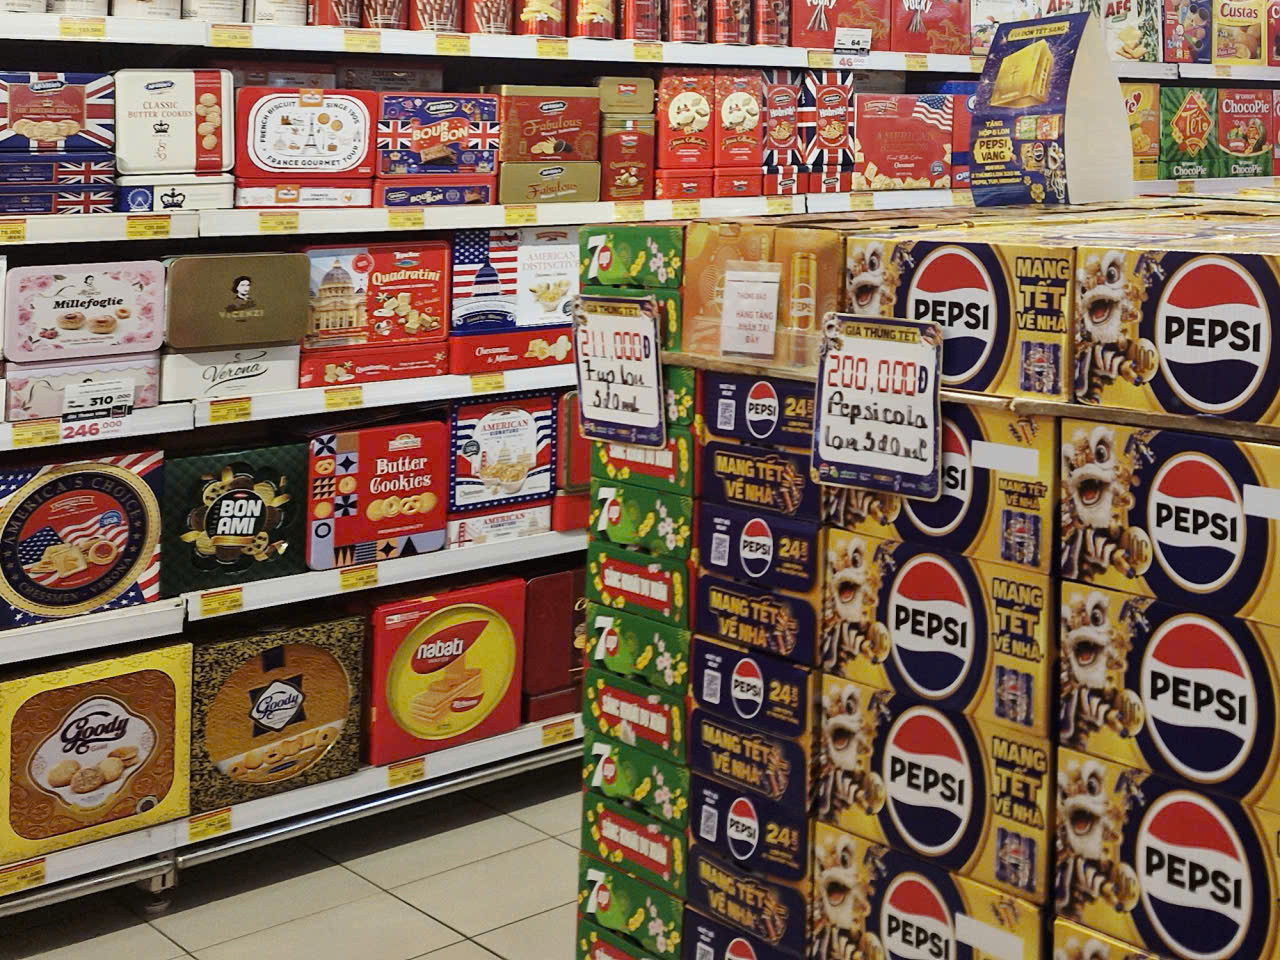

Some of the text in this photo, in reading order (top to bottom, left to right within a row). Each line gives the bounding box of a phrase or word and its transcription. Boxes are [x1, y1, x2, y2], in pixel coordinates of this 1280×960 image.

[1219, 2, 1259, 18] Custas
[839, 57, 853, 68] 46
[128, 110, 193, 118] BUTTER COOKIES
[143, 101, 177, 110] CLASSIC
[1222, 100, 1270, 114] ChocoPie
[260, 101, 297, 143] FRENCH BISCUIT
[523, 116, 583, 136] Fabulous
[412, 120, 469, 144] BOUR BON
[979, 140, 1008, 150] PEPSI
[266, 155, 299, 166] FRANCE
[342, 144, 359, 163] TOUR
[981, 150, 1006, 162] VÀNG
[1173, 165, 1207, 176] ChocoPie
[1231, 164, 1263, 175] ChocoPie
[528, 181, 578, 196] Fabulous
[371, 269, 441, 287] Quadratini
[1016, 257, 1070, 281] MANG
[53, 296, 124, 310] Millefoglie
[1020, 280, 1066, 310] TẾT
[219, 309, 265, 321] VICENZI
[914, 298, 990, 331] PEPSI
[1040, 310, 1068, 333] NHÀ
[1165, 316, 1261, 353] PEPSI
[202, 360, 262, 383] Verona
[90, 395, 114, 407] 310
[748, 402, 777, 417] PEPSI
[63, 422, 100, 440] 246
[481, 419, 529, 432] AMERICAN
[375, 457, 428, 475] Butter
[714, 454, 755, 478] MANG
[369, 474, 432, 494] Cookies
[90, 476, 143, 521] CHOICE
[219, 499, 263, 517] BON
[216, 517, 256, 536] AMI
[483, 512, 526, 526] AMERICAN
[1155, 502, 1238, 544] PEPSI
[894, 604, 967, 649] PEPSI
[416, 637, 464, 660] nabati
[255, 690, 300, 720] Goody
[1149, 669, 1248, 725] PEPSI
[60, 710, 129, 755] Goody
[890, 754, 966, 807] PEPSI
[1145, 845, 1242, 912] PEPSI
